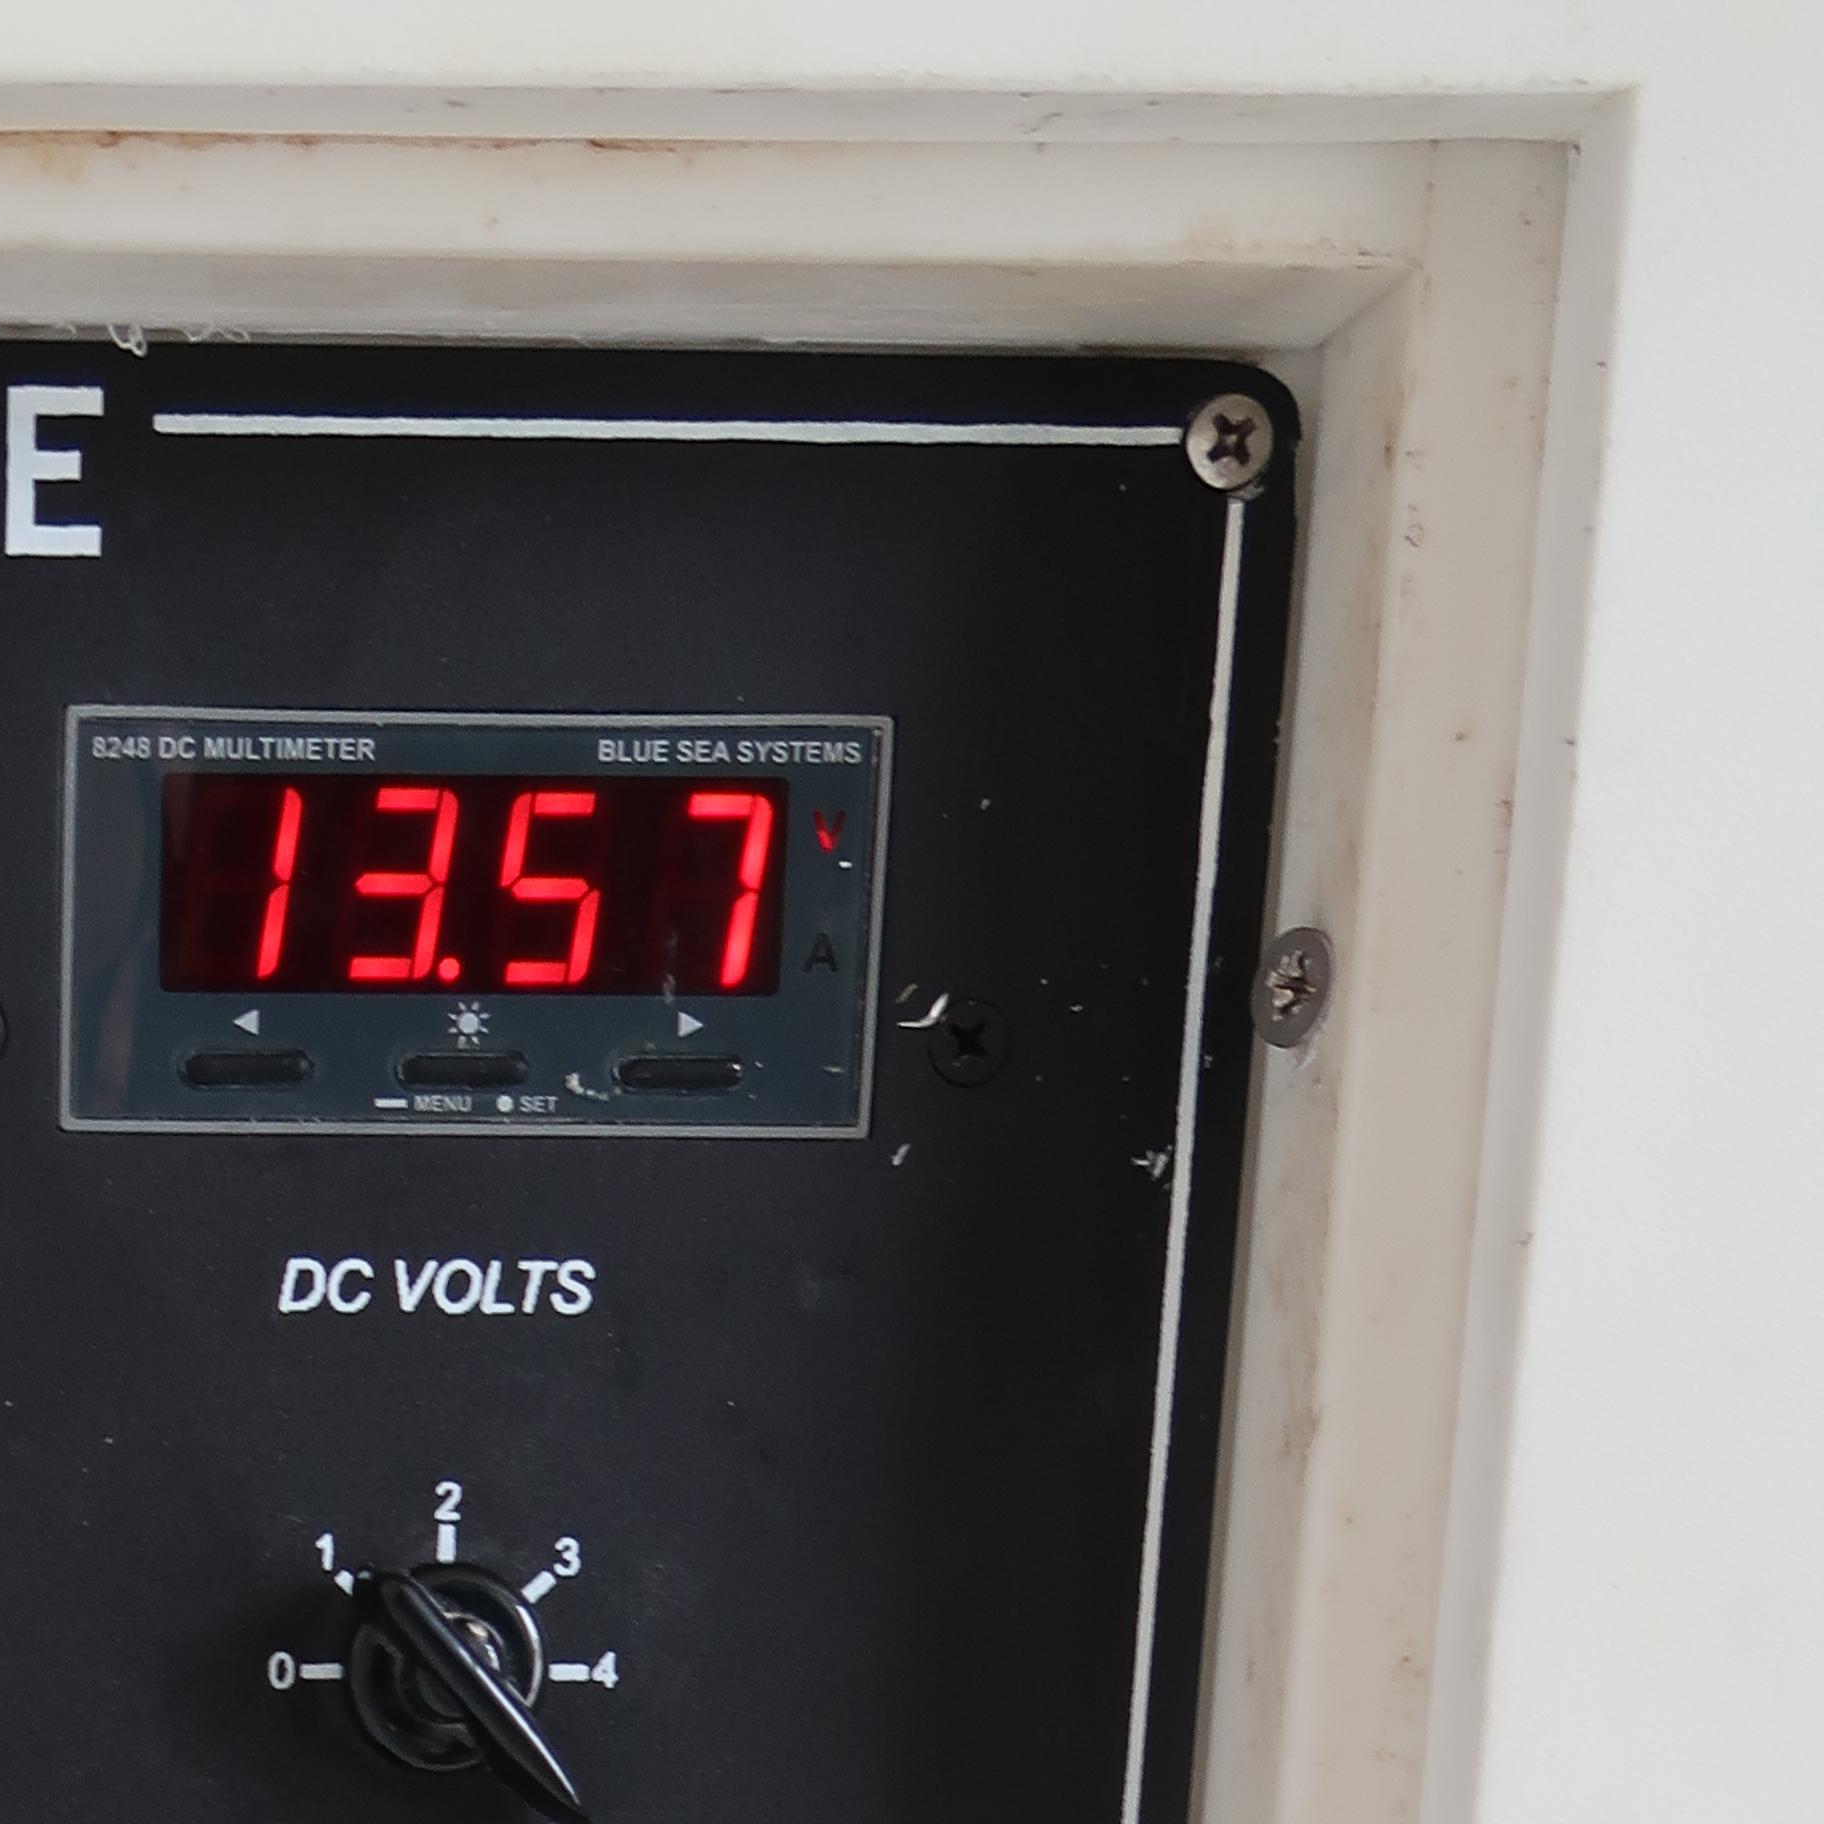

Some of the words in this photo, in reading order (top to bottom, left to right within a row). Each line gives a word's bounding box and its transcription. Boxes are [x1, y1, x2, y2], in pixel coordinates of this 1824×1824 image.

[92, 736, 151, 759] 8248
[158, 736, 196, 759] DC
[204, 736, 375, 761] MULTIMETER
[598, 739, 670, 762] BLUE
[676, 740, 730, 763] SEA
[736, 740, 861, 764] SYSTEMS
[812, 810, 846, 854] V
[256, 786, 775, 987] 13.57
[414, 1094, 472, 1112] MENU
[519, 1095, 558, 1113] SET
[277, 1257, 374, 1313] DC
[394, 1258, 596, 1315] VOLTS
[434, 1481, 462, 1521] 2
[315, 1533, 334, 1571] 1
[554, 1537, 581, 1575] 3
[268, 1651, 295, 1690] 0
[591, 1651, 619, 1689] 4
